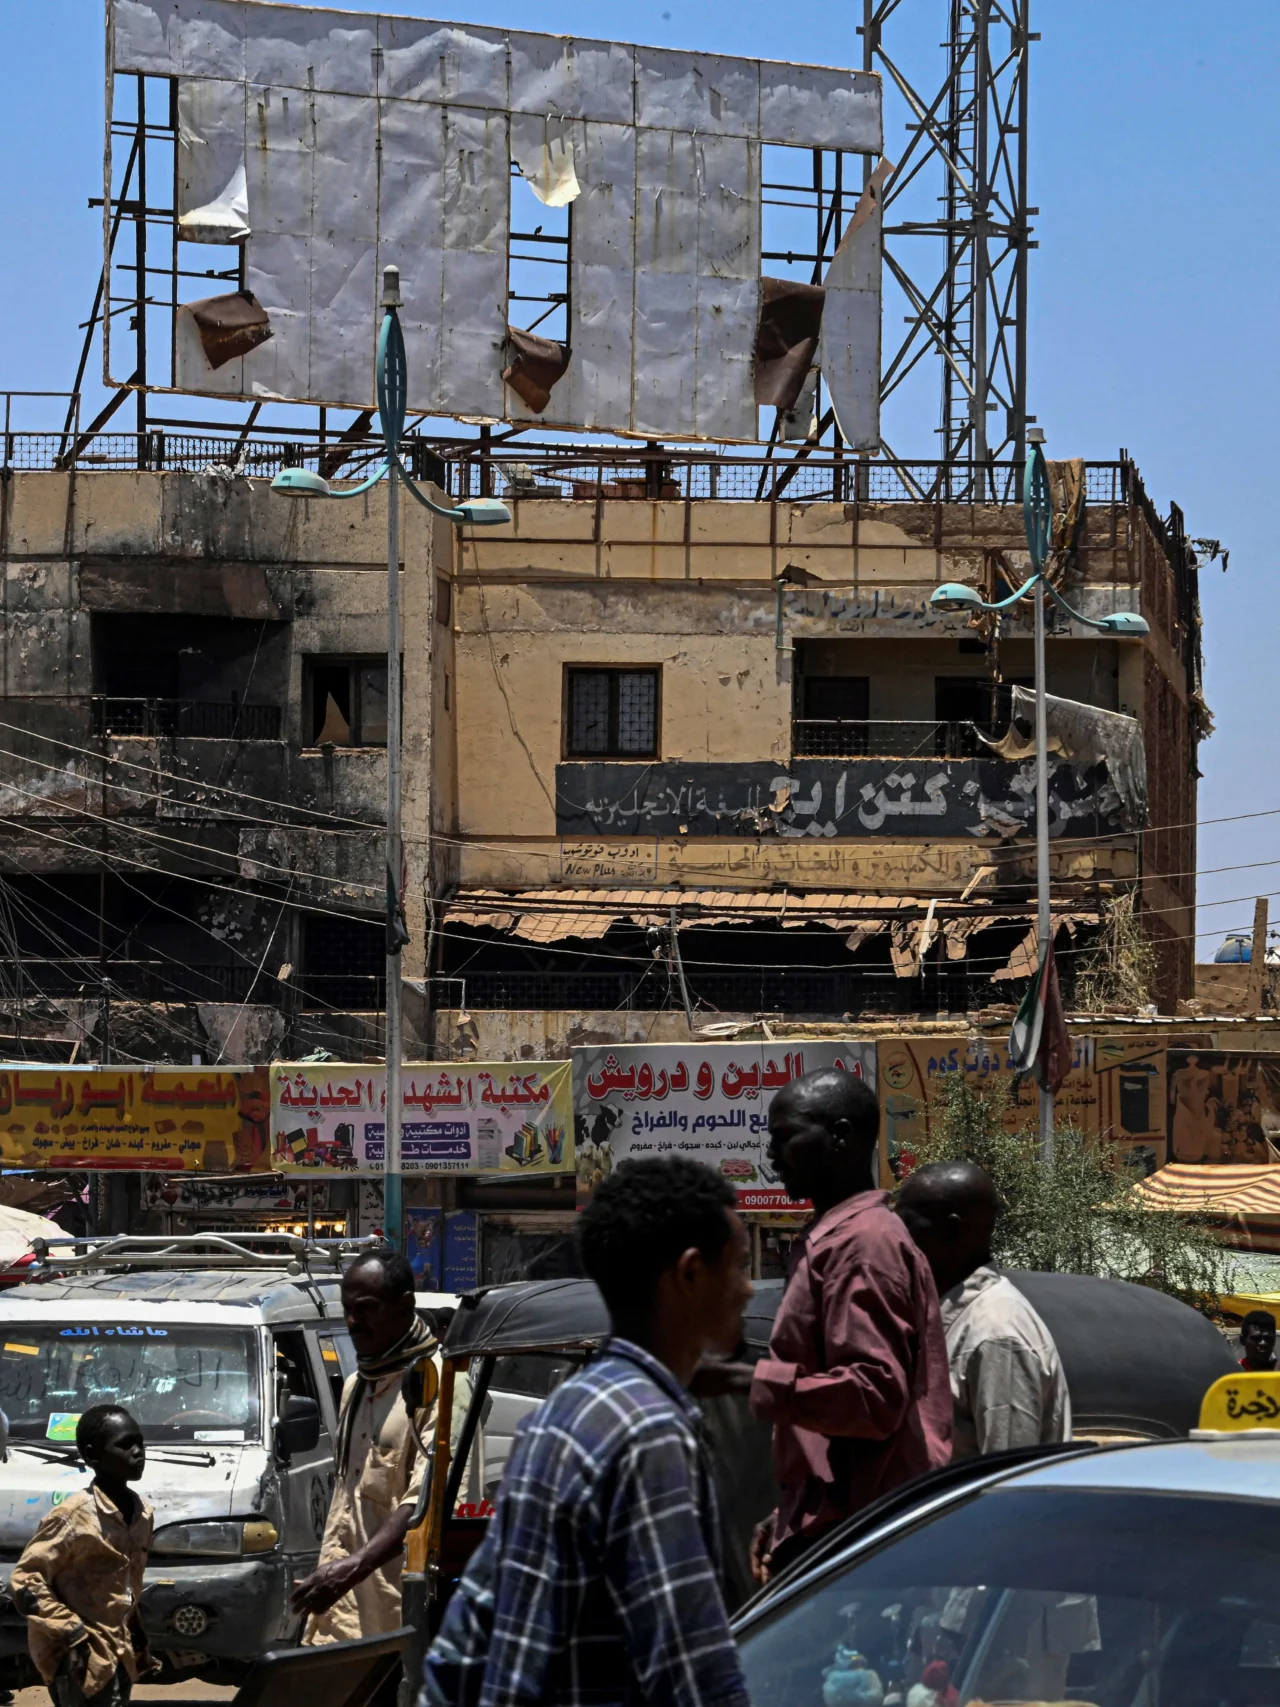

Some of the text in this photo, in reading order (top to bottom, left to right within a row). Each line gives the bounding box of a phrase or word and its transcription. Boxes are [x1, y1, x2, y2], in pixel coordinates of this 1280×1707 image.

[565, 863, 592, 875] New
[594, 863, 616, 877] Plus
[586, 1053, 690, 1101] درويش
[693, 1061, 715, 1100] و
[721, 1051, 803, 1100] الدين
[140, 1073, 237, 1111] ملحمة
[277, 1072, 373, 1117] الحديثة
[478, 1072, 549, 1113] مكتبة
[631, 1110, 688, 1135] والفراخ
[692, 1109, 746, 1134] اللحوم
[405, 1124, 443, 1139] مكتبية
[32, 1137, 54, 1150] سجوك
[60, 1138, 75, 1150] بيض
[82, 1137, 99, 1150] فراخ
[151, 1138, 171, 1151] مفروم
[421, 1143, 468, 1155] خدمات
[629, 1142, 653, 1152] مفروم
[657, 1140, 673, 1152] فراخ
[677, 1140, 701, 1151] سجوك
[705, 1140, 723, 1150] كبده
[727, 1141, 739, 1150] لبن
[739, 1140, 761, 1152] عجالي
[425, 1162, 469, 1170] 0901357111
[59, 1326, 169, 1337] ماشاء الله
